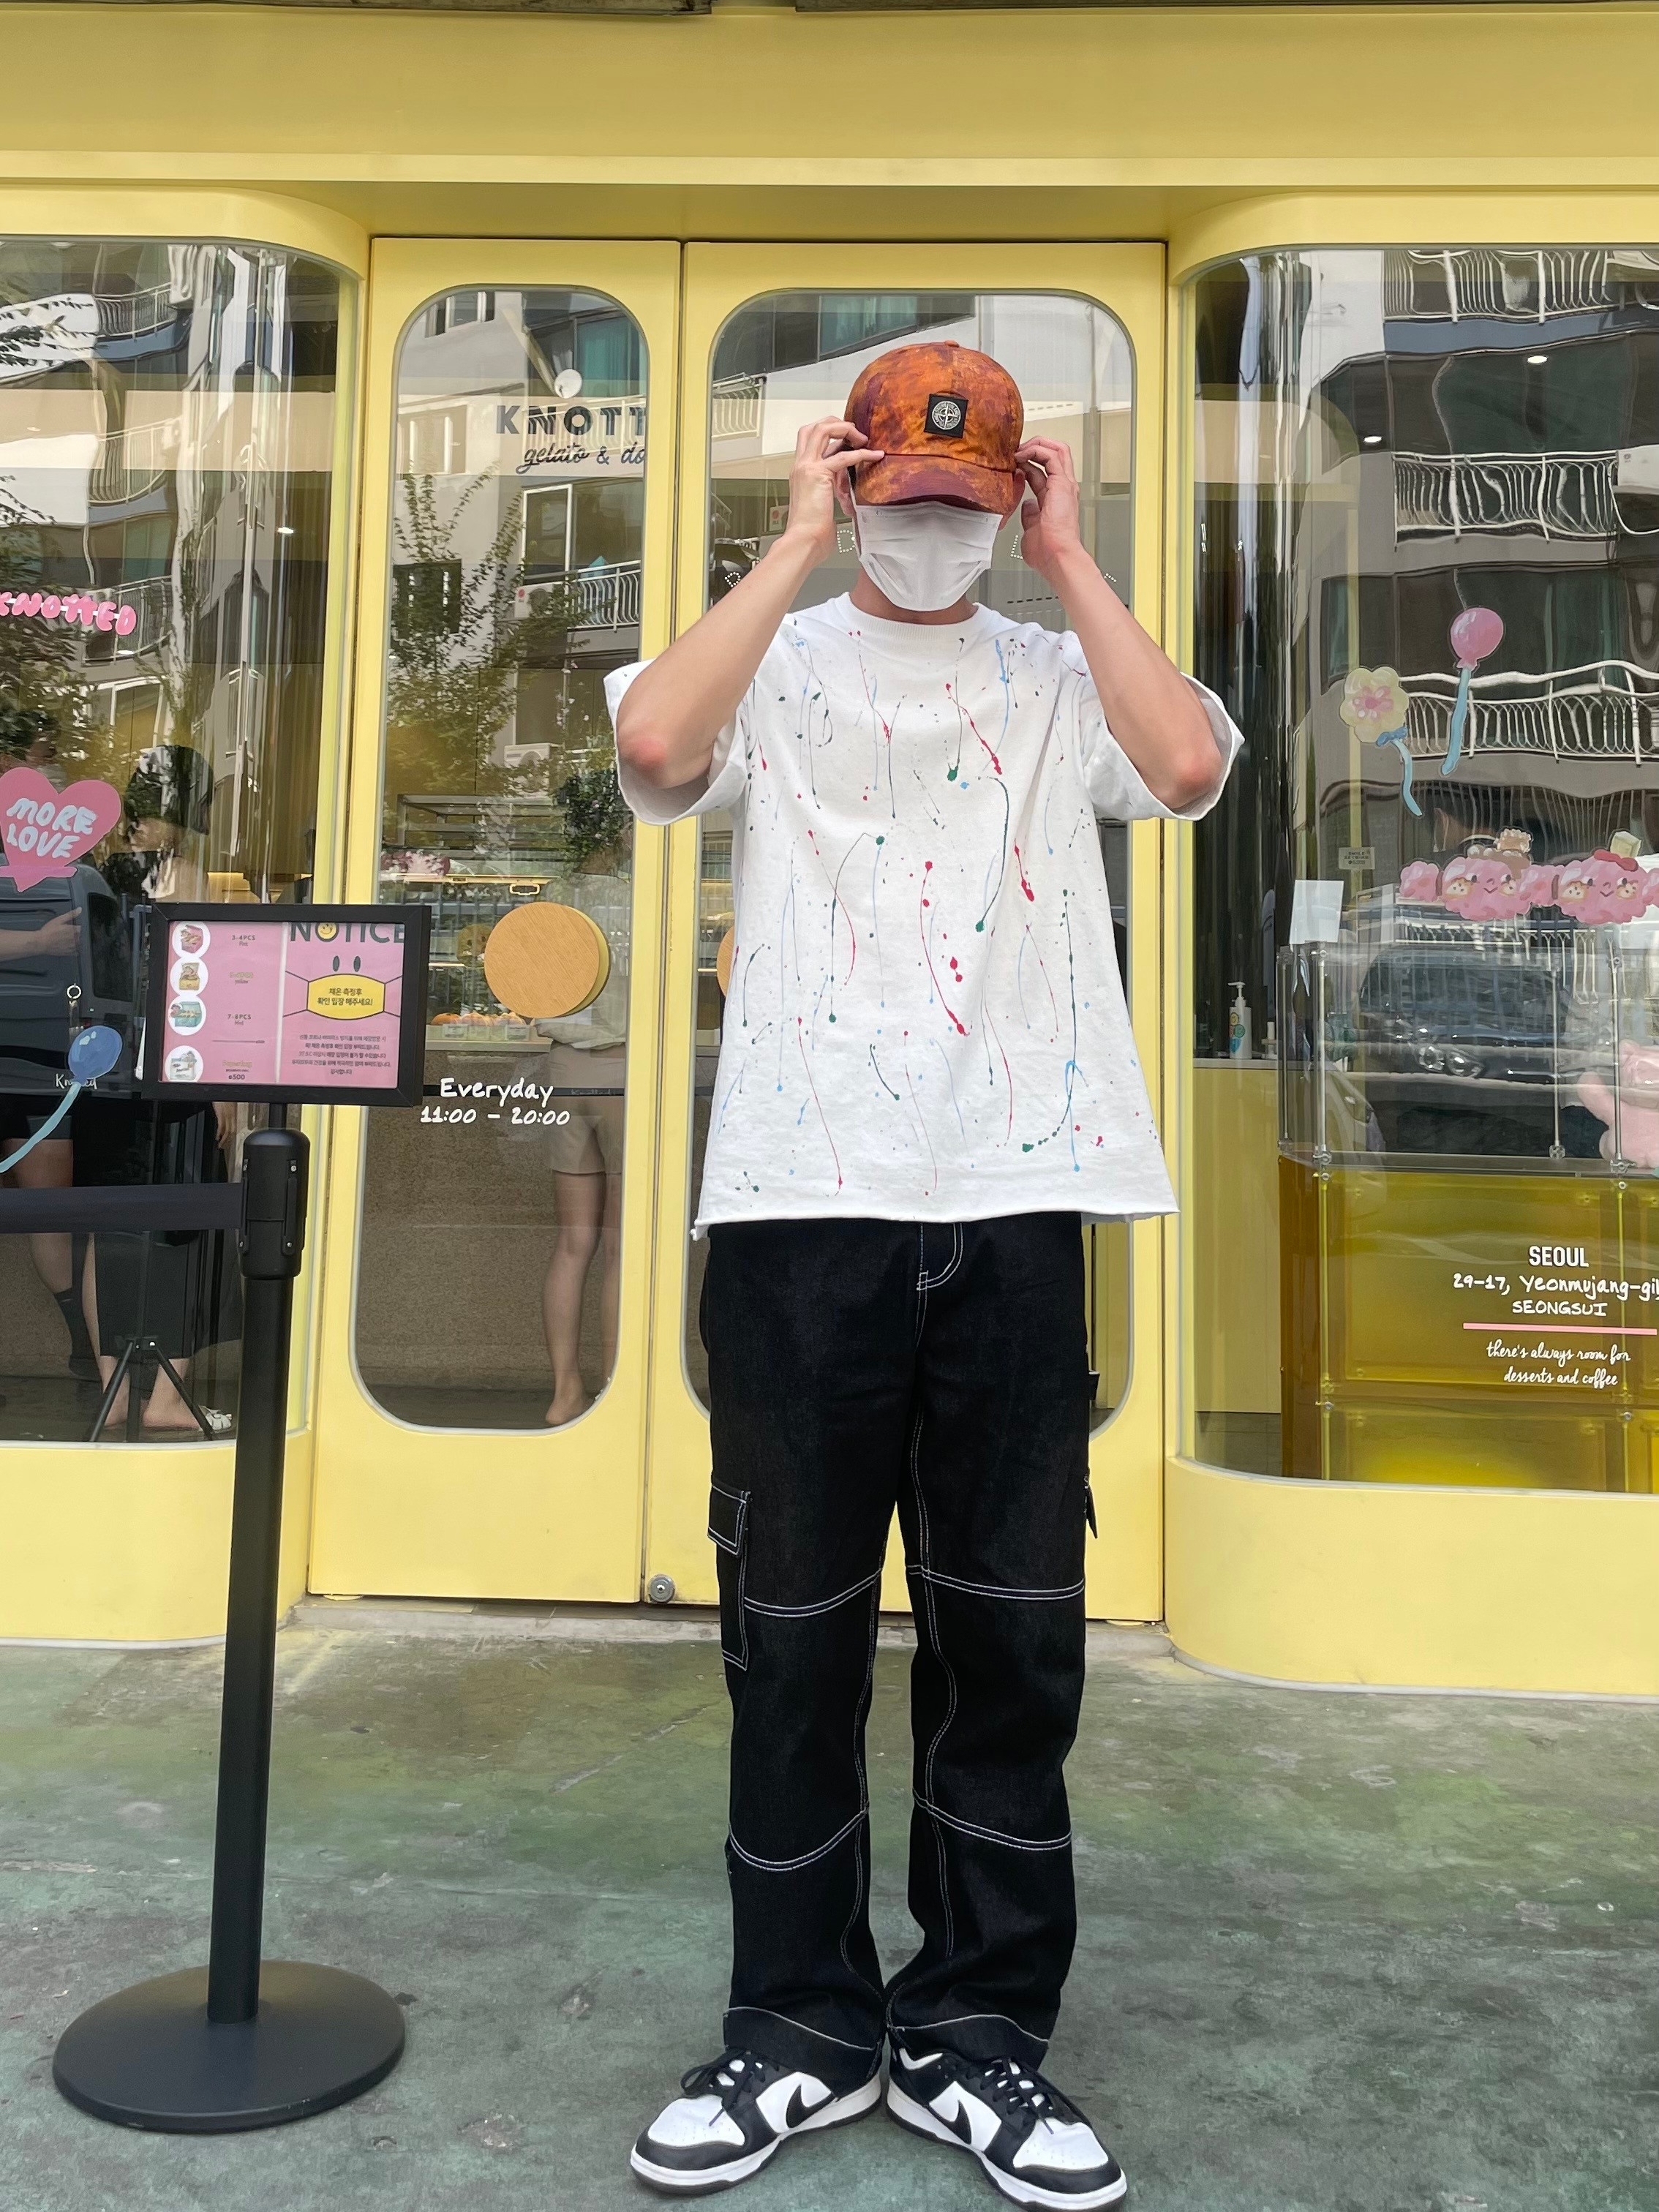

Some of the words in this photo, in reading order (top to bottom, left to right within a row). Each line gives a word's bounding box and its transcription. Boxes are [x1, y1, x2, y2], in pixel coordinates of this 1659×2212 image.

[515, 441, 590, 475] gelato
[596, 445, 609, 464] &
[6, 797, 97, 835] MORE
[7, 823, 81, 859] LOVE
[56, 1073, 97, 1090] Kned
[440, 1077, 554, 1108] Everyday
[420, 1105, 477, 1124] 11:00
[511, 1106, 571, 1125] 20:00
[1529, 1246, 1590, 1268] SEOUL
[1453, 1273, 1511, 1295] 29-17,
[1512, 1300, 1608, 1317] SEONGSUI
[1486, 1339, 1528, 1358] there's
[1530, 1342, 1573, 1368] always
[1576, 1351, 1608, 1361] room
[1609, 1344, 1631, 1365] for
[1504, 1366, 1555, 1384] desserts
[1556, 1368, 1579, 1385] and
[1581, 1368, 1619, 1389] coffee
